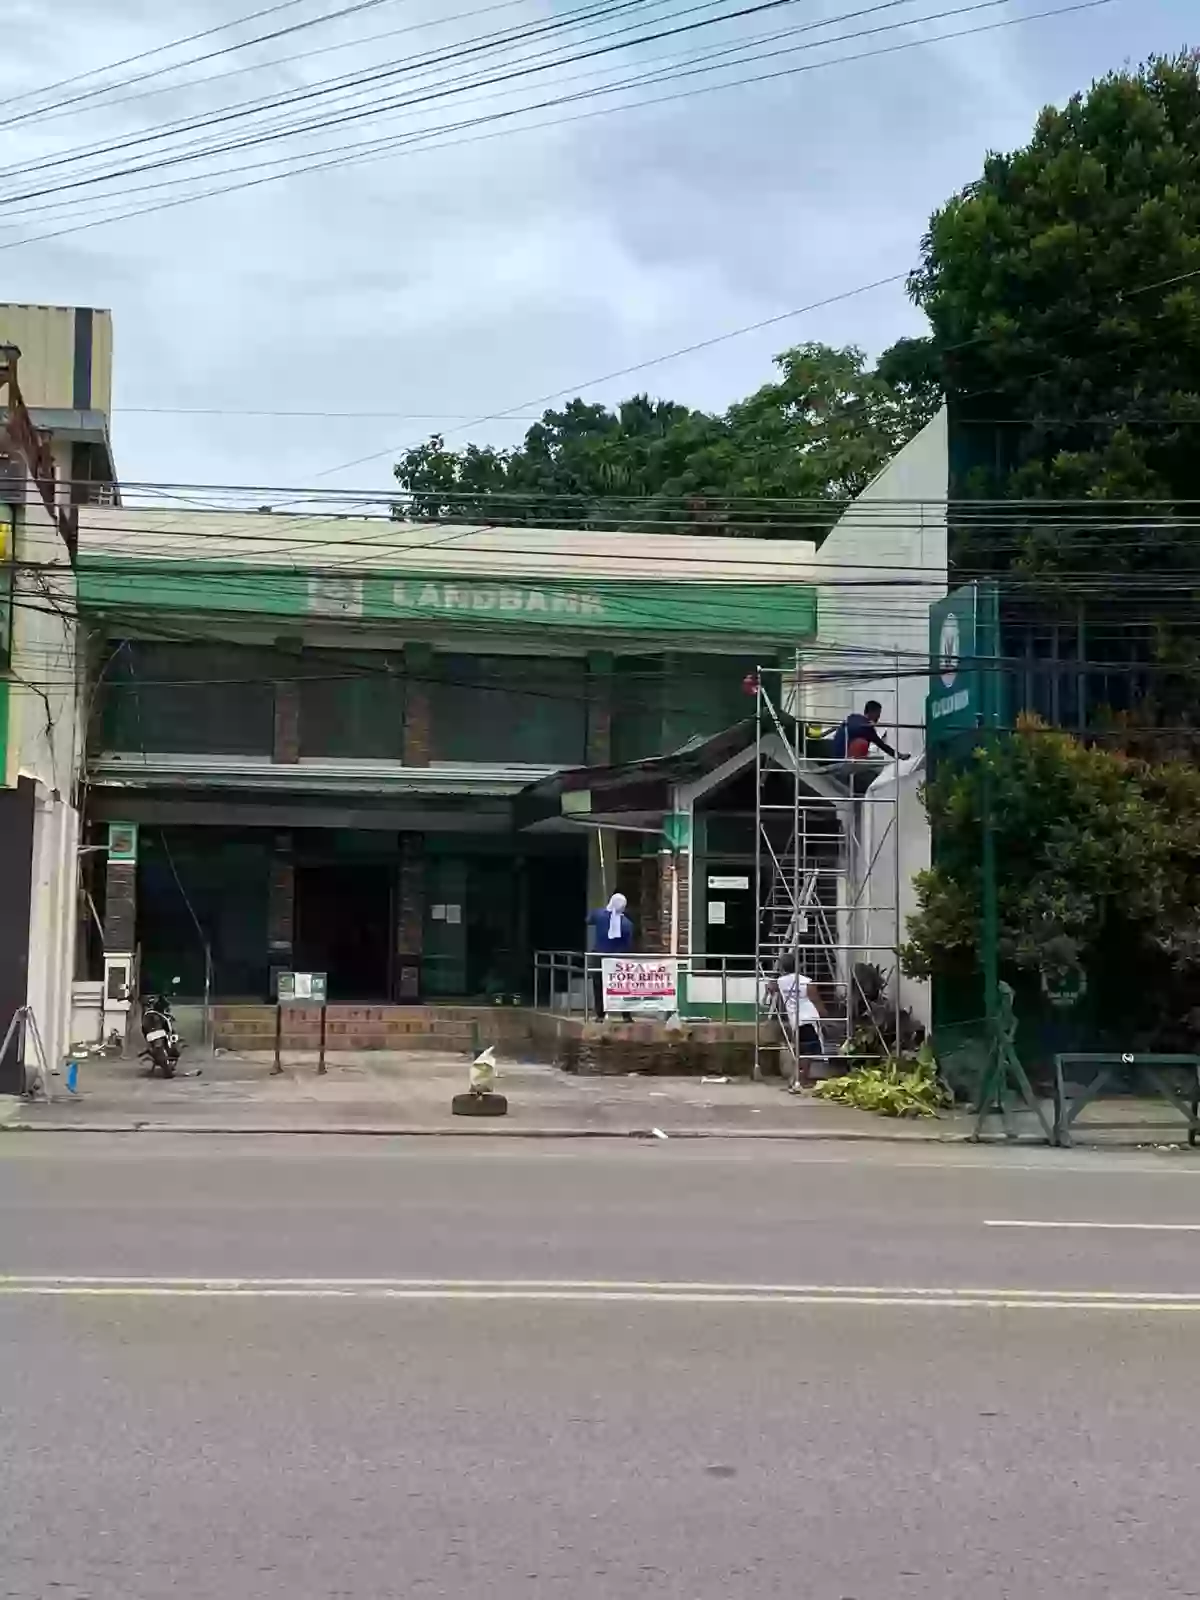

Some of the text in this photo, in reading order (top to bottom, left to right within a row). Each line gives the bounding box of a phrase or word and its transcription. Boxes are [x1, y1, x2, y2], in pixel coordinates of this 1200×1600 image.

[392, 580, 606, 614] LANDBANK
[608, 972, 673, 982] FOR RENT
